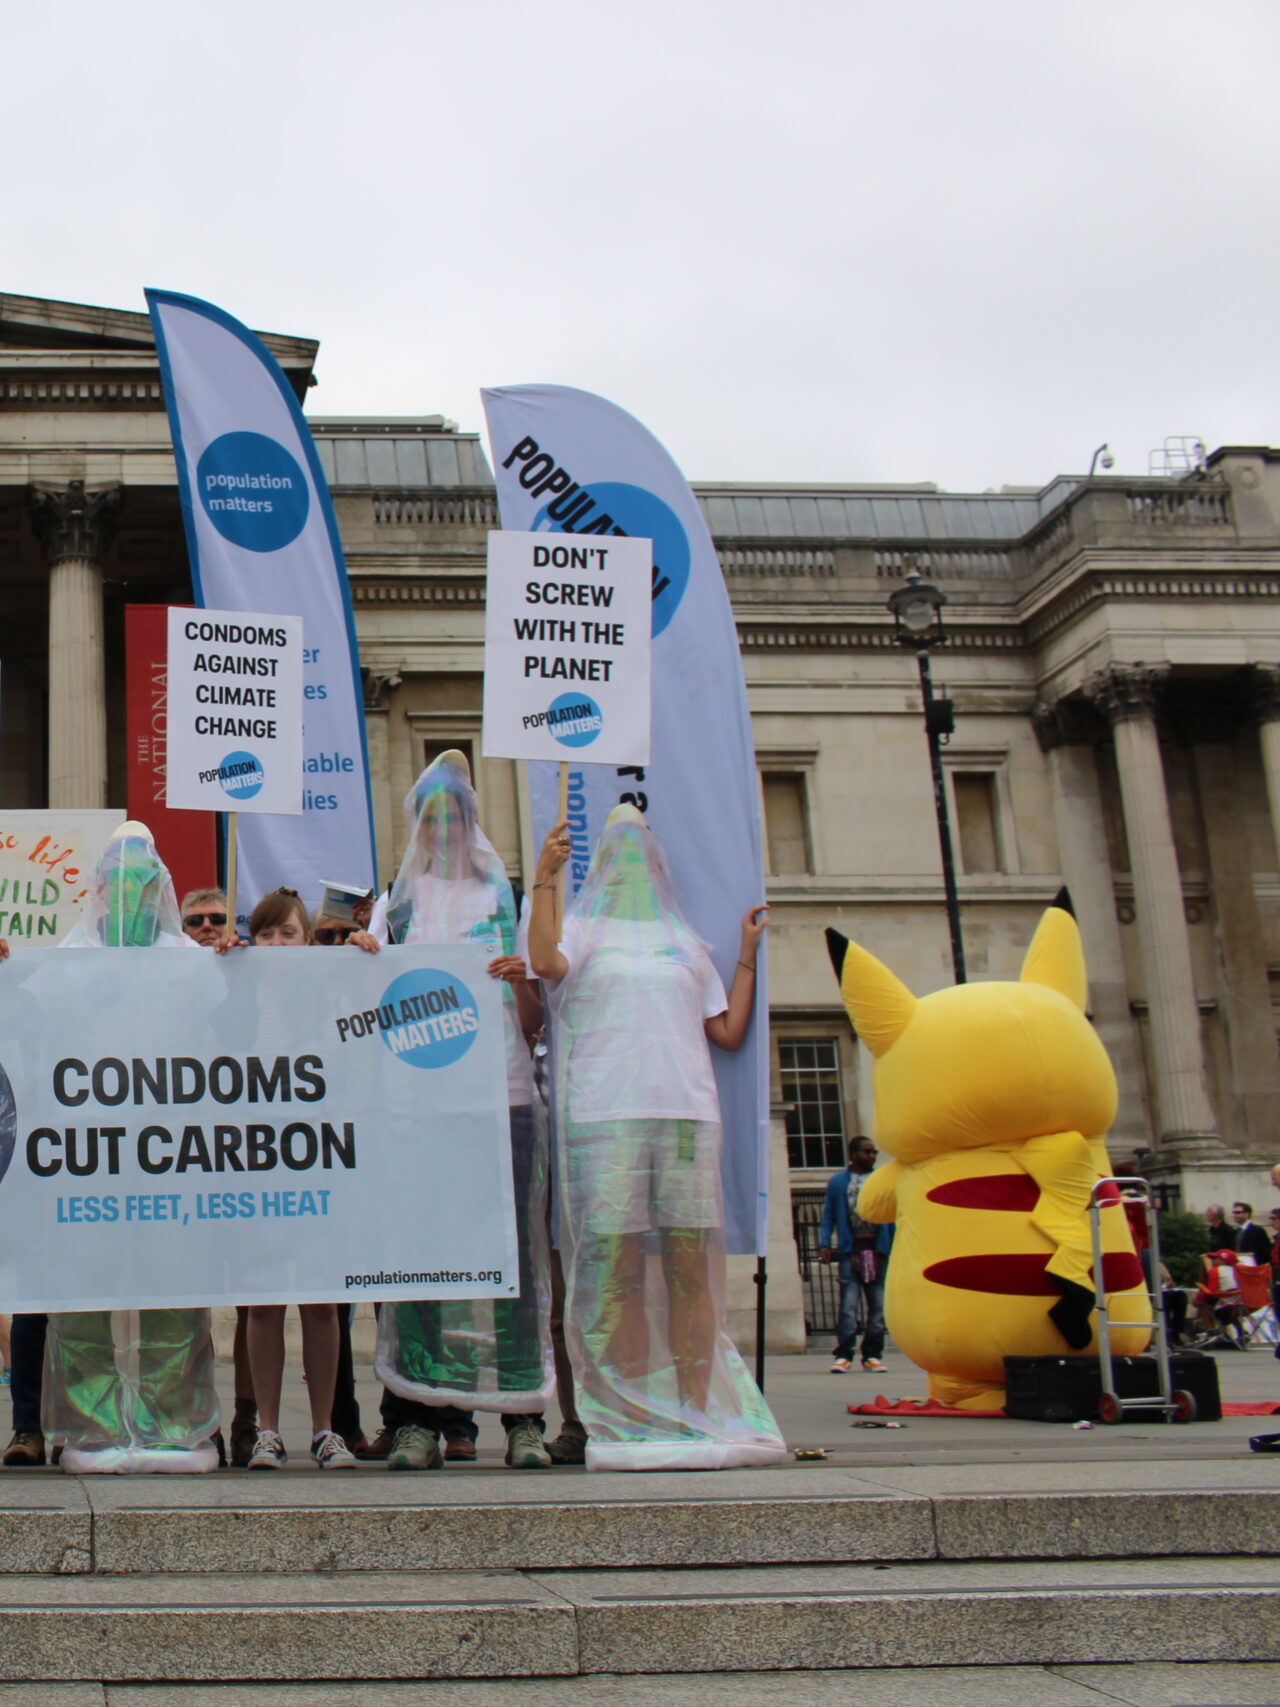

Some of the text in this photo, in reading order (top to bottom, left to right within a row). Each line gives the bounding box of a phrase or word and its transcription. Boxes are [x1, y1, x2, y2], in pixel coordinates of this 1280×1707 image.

[206, 473, 292, 491] population
[209, 497, 273, 512] matters
[533, 545, 608, 570] DON'T
[525, 582, 614, 607] SCREW
[185, 621, 287, 647] CONDOMS
[514, 618, 624, 646] WITH THE
[193, 653, 278, 677] AGAINST
[524, 656, 613, 682] PLANET
[196, 684, 276, 708] CLIMATE
[195, 716, 276, 739] CHANGE
[522, 703, 592, 730] POPULATION
[549, 716, 602, 739] MATTERS
[138, 735, 149, 765] THE
[199, 760, 256, 783] POPULATION
[221, 771, 264, 791] MATTERS
[335, 986, 460, 1042] POPULATION
[387, 1006, 479, 1054] MATTERS
[53, 1054, 326, 1107] CONDOMS
[26, 1122, 356, 1177] CUT CARBON
[57, 1190, 330, 1226] LESS FEET, LESS HEAT
[345, 1269, 502, 1289] populationmatters.org
